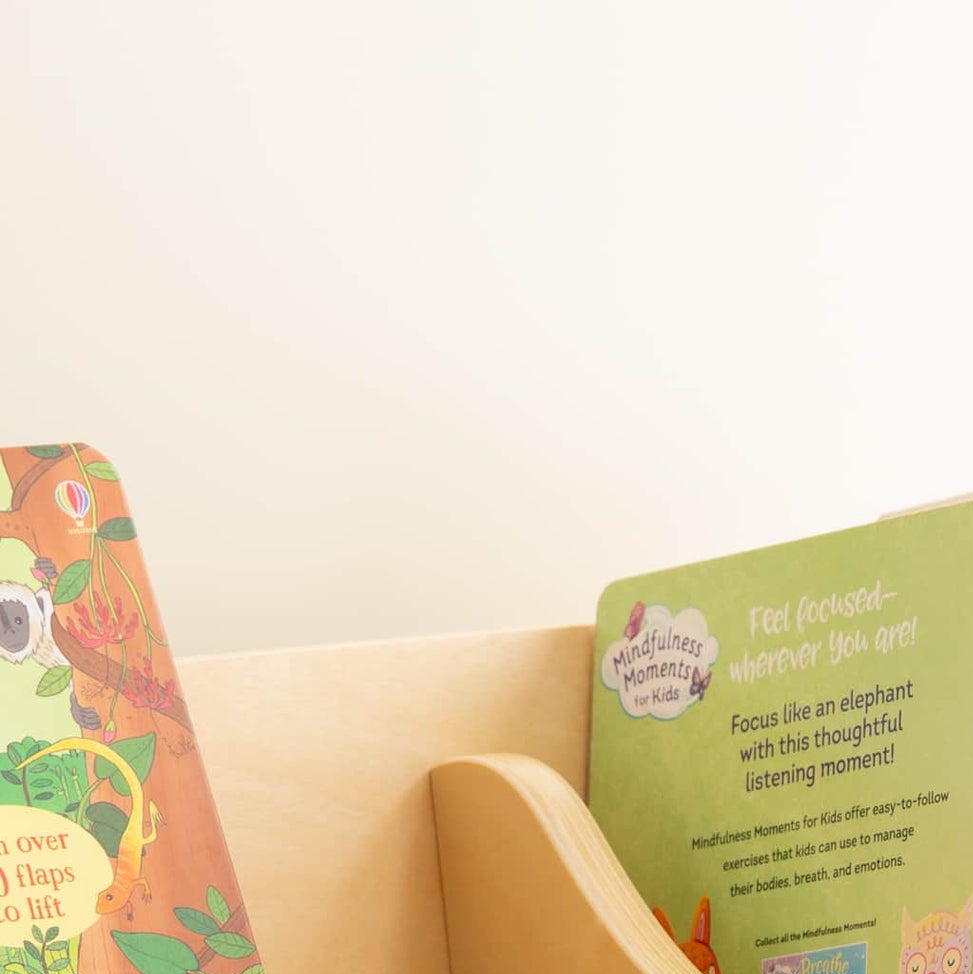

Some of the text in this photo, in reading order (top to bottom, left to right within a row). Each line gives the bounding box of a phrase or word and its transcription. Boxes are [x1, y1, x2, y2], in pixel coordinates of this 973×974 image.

[749, 600, 790, 640] Feel
[613, 627, 703, 675] Mindfulness
[729, 640, 822, 684] wherever
[875, 615, 918, 655] are!
[624, 657, 691, 692] Moments
[634, 685, 681, 708] for Kids
[731, 679, 914, 735] Focus like an elephant
[739, 710, 904, 763] with this thoughtful
[745, 743, 895, 793] listening moment!
[691, 790, 950, 850] Mindfulness Moments for Kids offer easy-to-follow
[16, 833, 69, 853] over
[723, 825, 915, 872] exercises that kids can use to manage
[16, 863, 76, 891] flaps
[730, 854, 905, 897] their bodies, breath, and emotions.
[0, 894, 66, 923] o lift
[755, 936, 779, 948] Collect
[780, 933, 789, 943] all
[790, 931, 801, 941] the
[802, 925, 842, 939] Mindfulness
